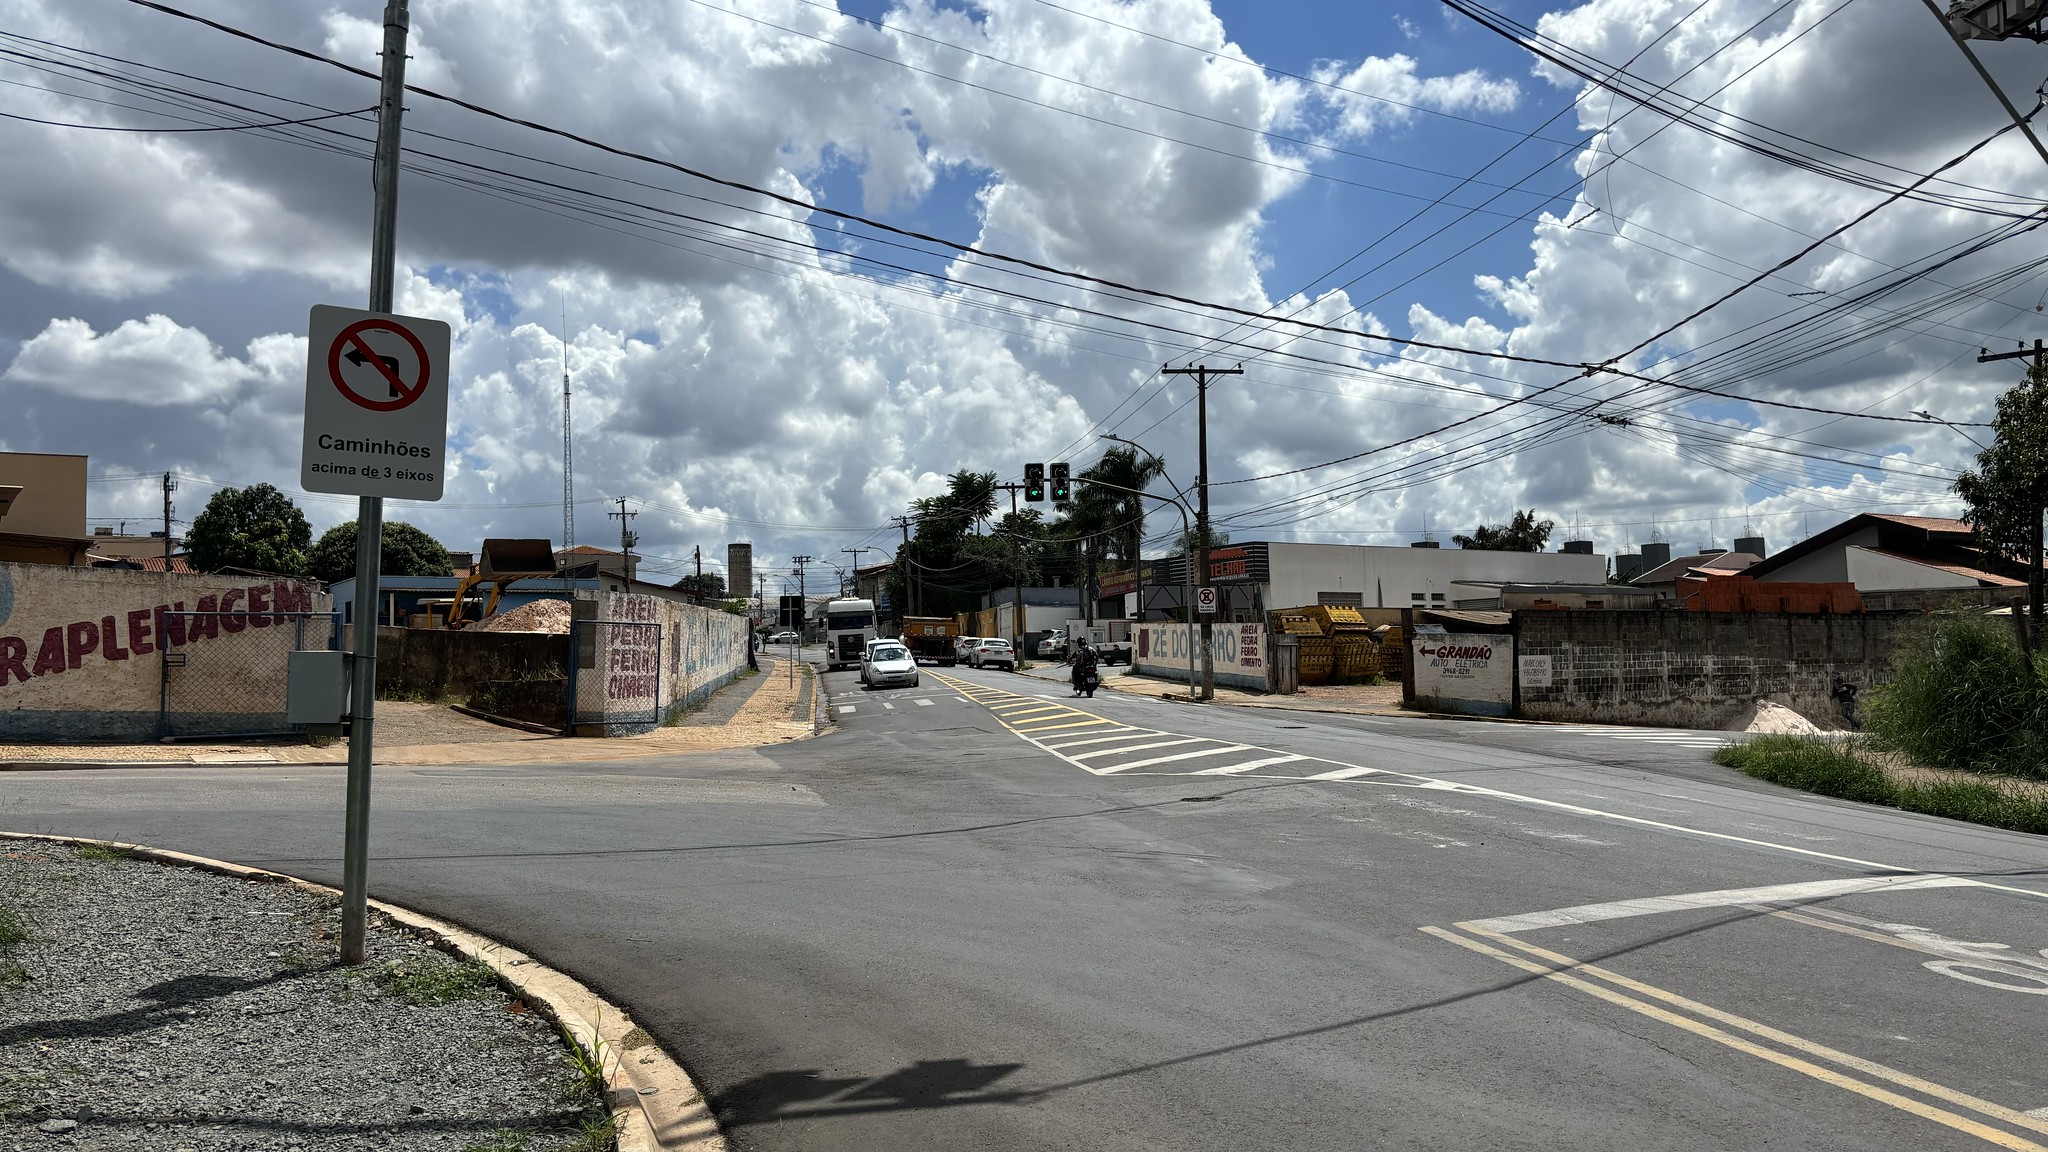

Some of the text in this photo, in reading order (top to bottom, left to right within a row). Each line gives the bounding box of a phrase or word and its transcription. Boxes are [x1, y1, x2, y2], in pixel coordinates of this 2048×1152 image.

[318, 434, 431, 459] Caminhões
[311, 462, 434, 482] acima de 3 eixos
[0, 578, 312, 687] RAPLENAGEM
[1240, 625, 1258, 635] AREIA
[1152, 624, 1236, 664] ZÉ DO BRRO
[1240, 635, 1258, 646] PEDRA
[1240, 646, 1258, 657] FERRO
[1436, 644, 1492, 660] GRANDÃO
[1240, 657, 1262, 668] CIMENTO
[1430, 658, 1449, 667] AUTO
